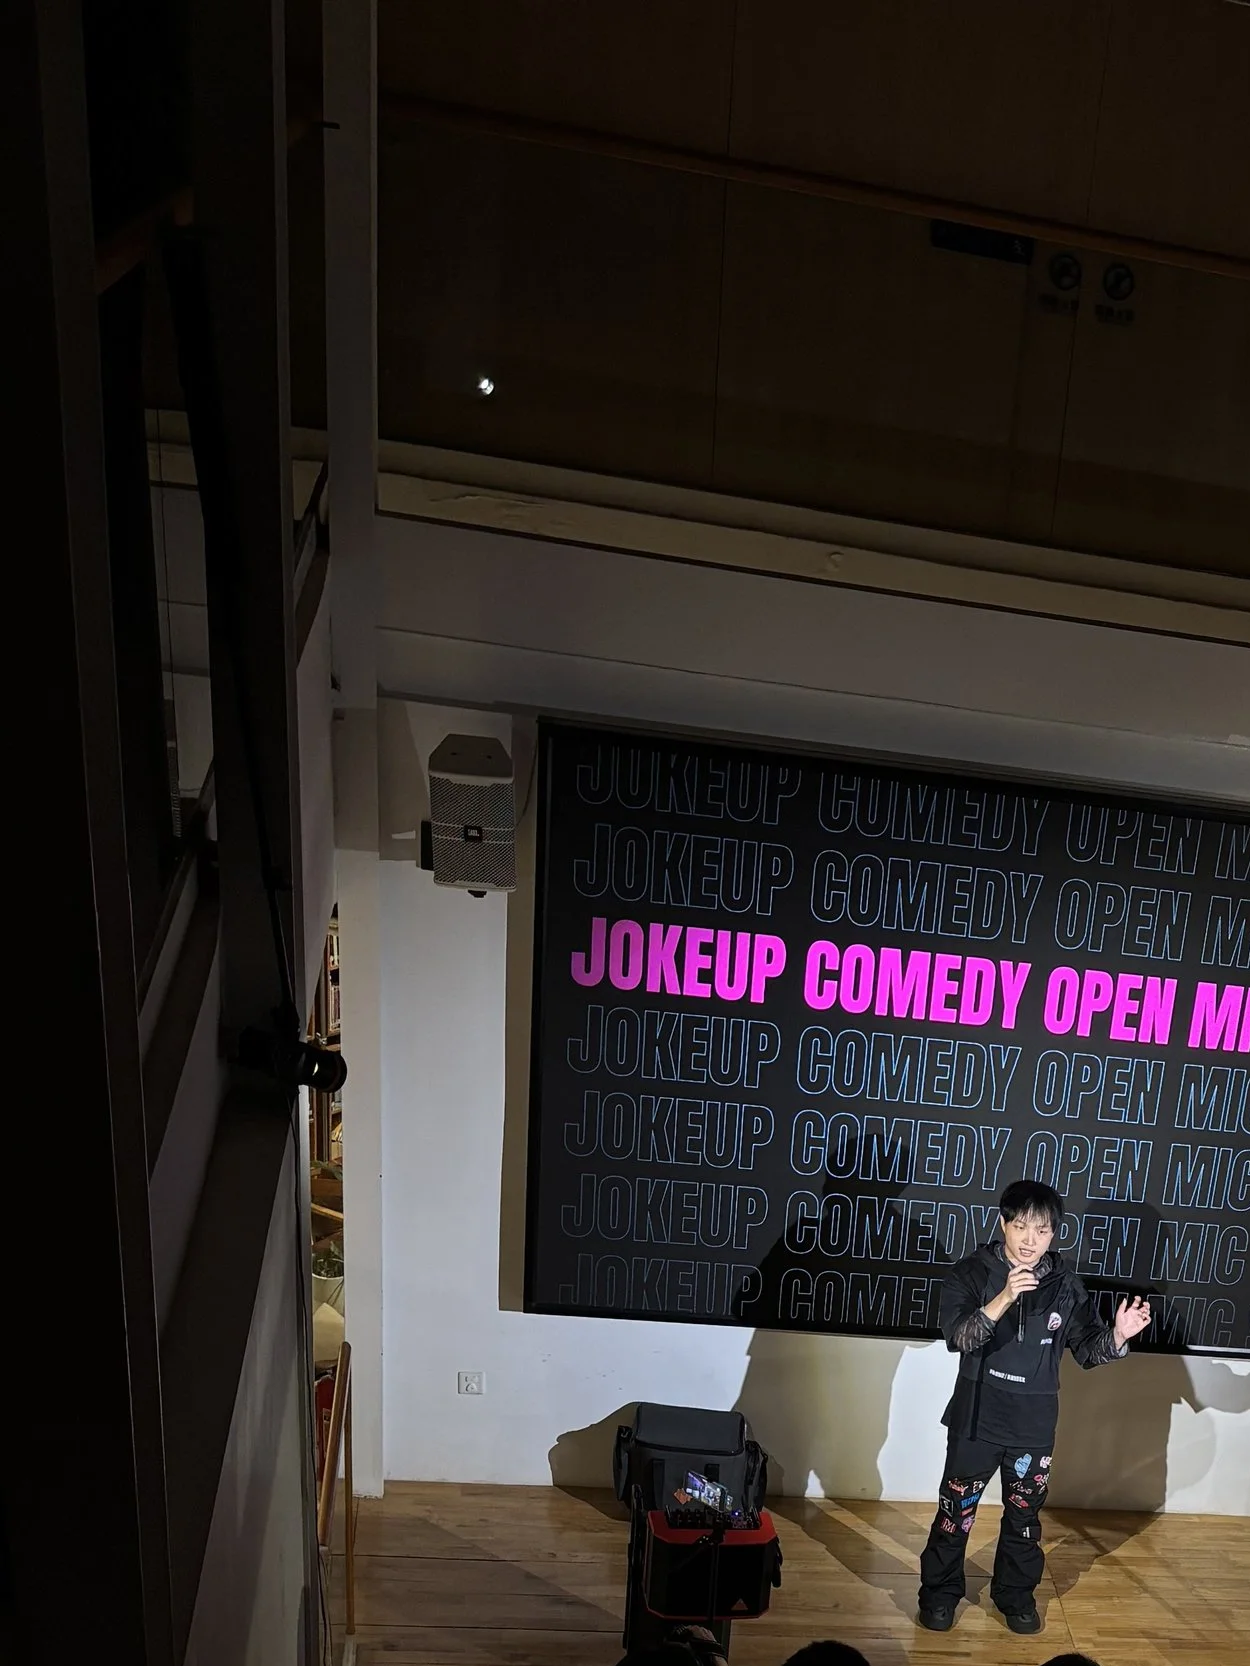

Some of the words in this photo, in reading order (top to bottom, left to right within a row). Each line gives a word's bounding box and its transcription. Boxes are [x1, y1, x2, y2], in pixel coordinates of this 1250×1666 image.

[573, 823, 794, 916] JOKEUP
[810, 849, 1044, 944] COMEDY
[1055, 878, 1192, 962] OPEN
[1066, 802, 1202, 876] OPEN
[569, 916, 788, 1004] JOKEUP
[803, 939, 1032, 1030] COMEDY
[1042, 966, 1178, 1046] OPEN
[566, 1004, 781, 1089] JOKEUP
[796, 1025, 1022, 1112] COMEDY
[1032, 1049, 1166, 1126] OPEN
[563, 1090, 775, 1171] JOKEUP
[789, 1108, 1013, 1191] COMEDY
[1022, 1130, 1153, 1204] OPEN
[560, 1173, 769, 1249] JOKEUP
[1058, 1211, 1140, 1278] PEN
[1150, 1219, 1250, 1287] MIC
[558, 1253, 763, 1320] JOKEUP
[778, 1266, 942, 1328] COME
